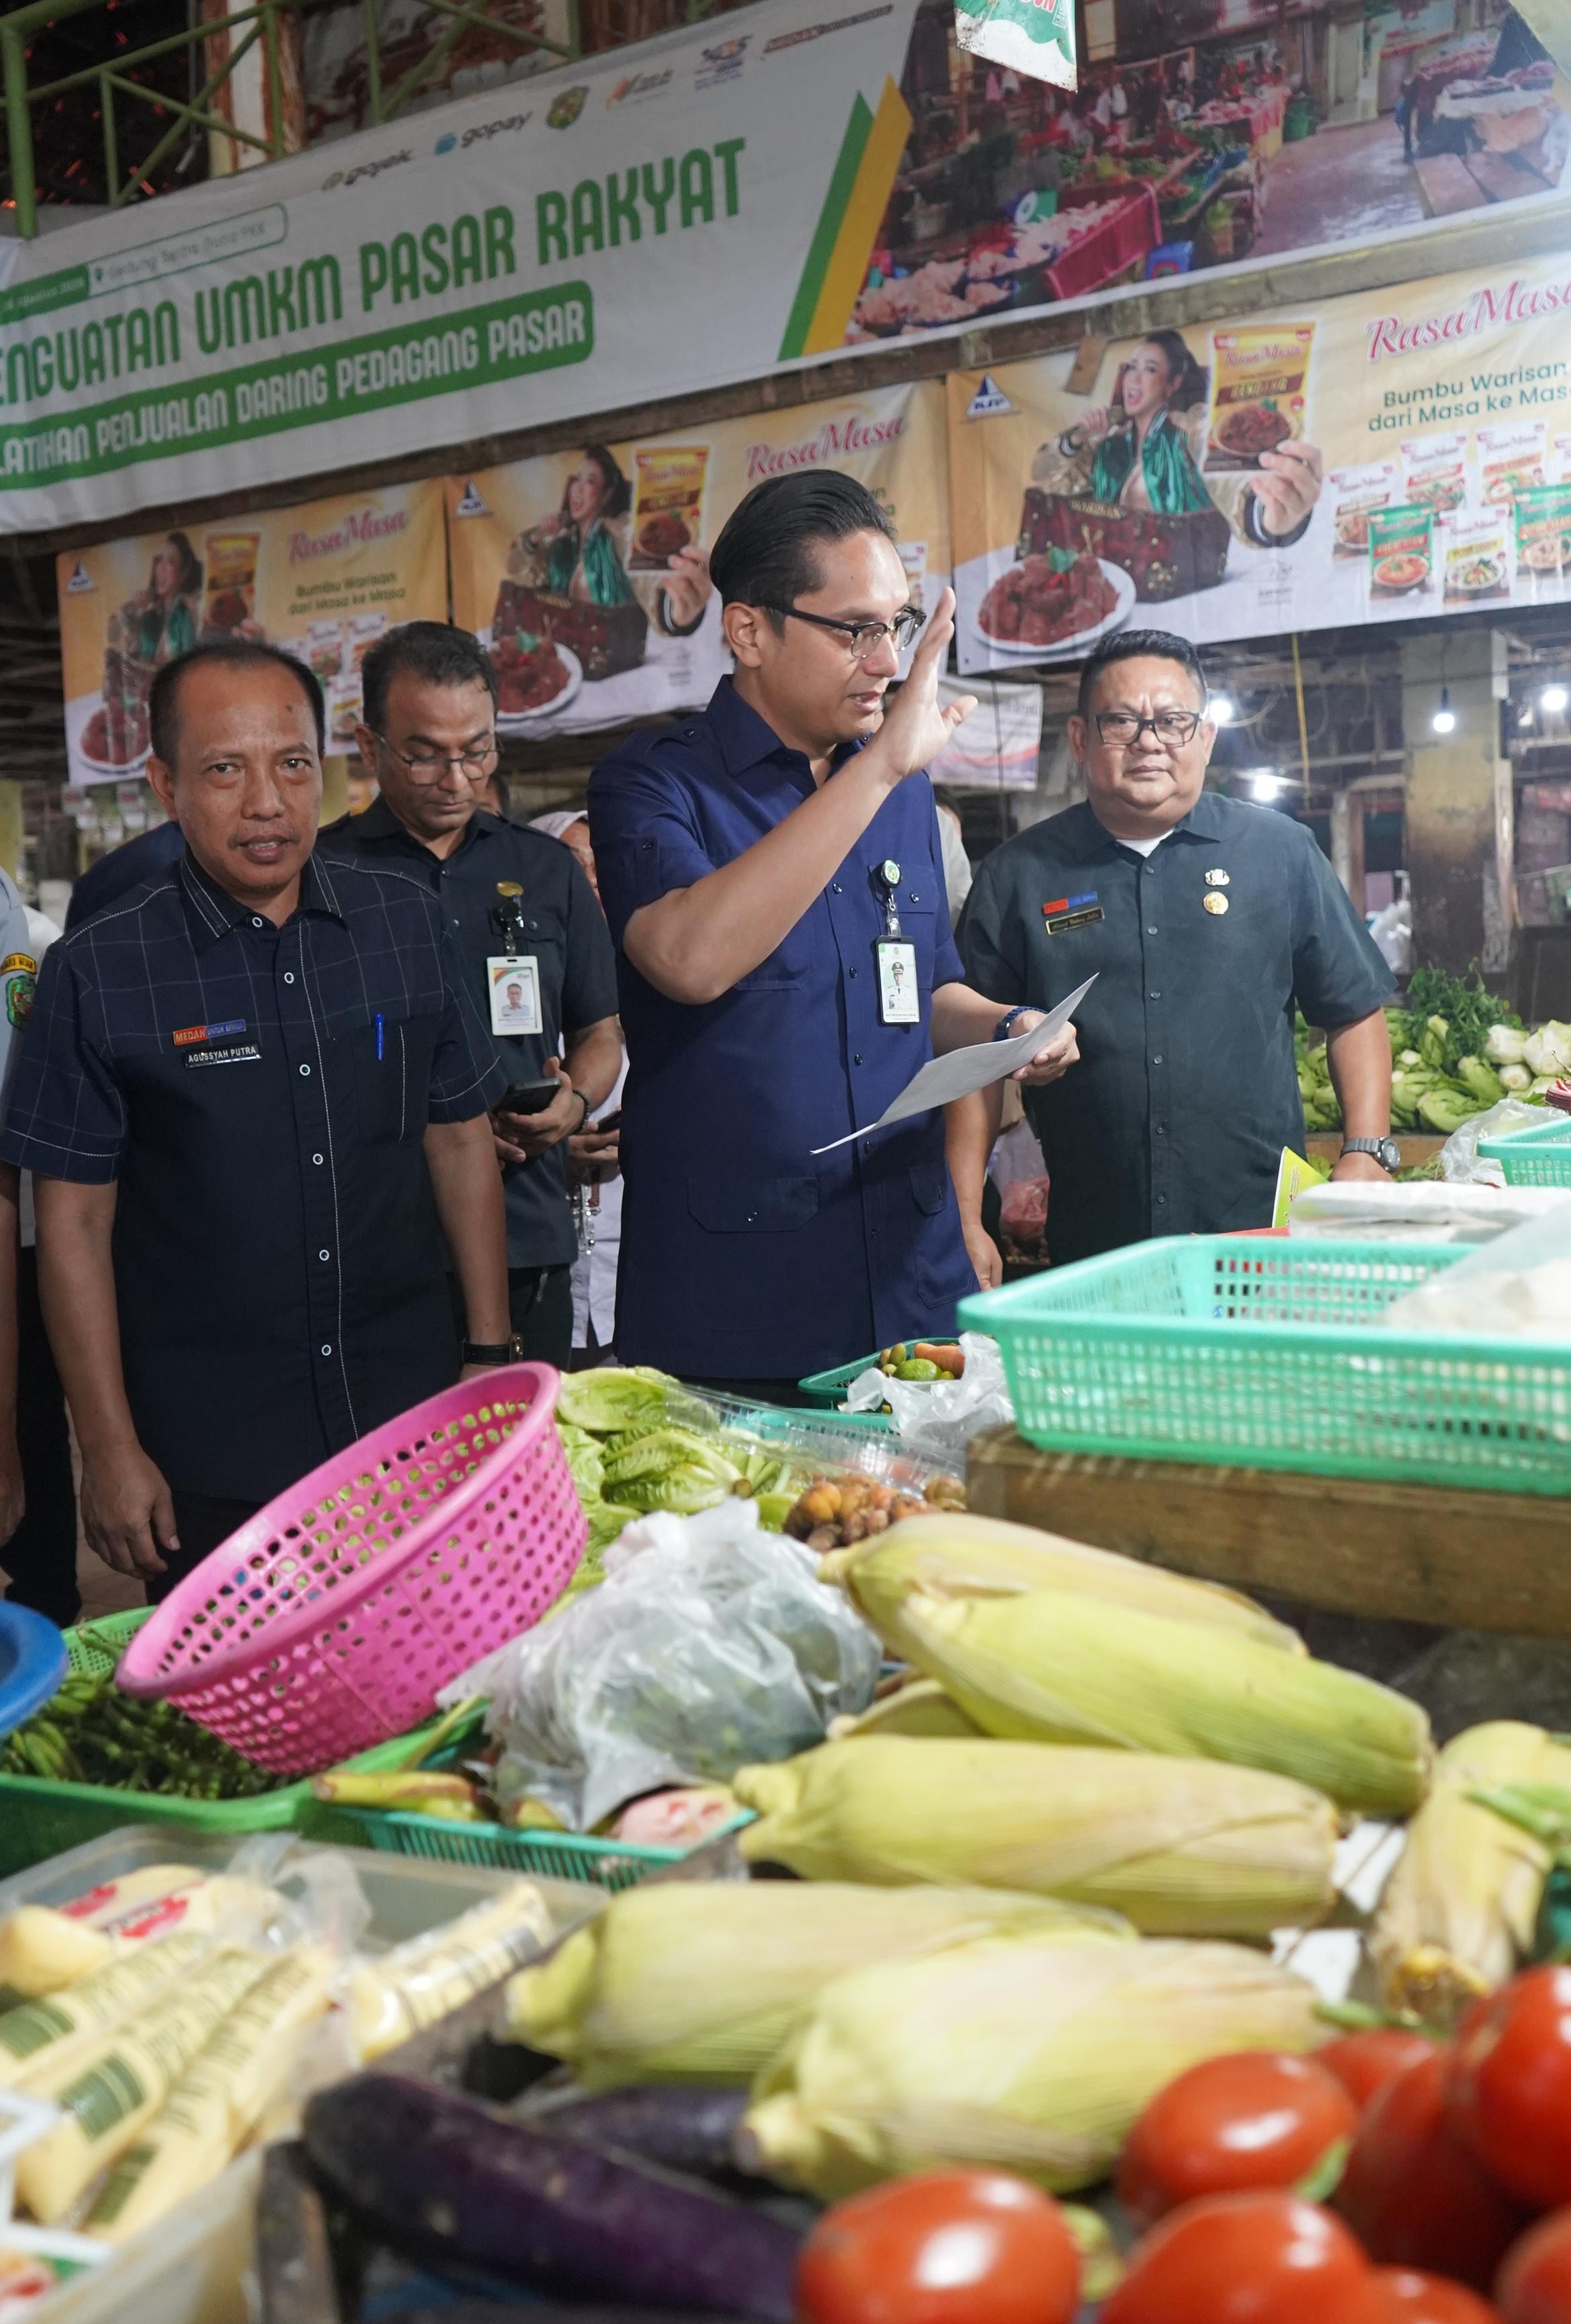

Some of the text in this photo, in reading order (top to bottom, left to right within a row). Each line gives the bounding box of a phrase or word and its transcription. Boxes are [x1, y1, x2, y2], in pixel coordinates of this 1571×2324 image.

[0, 137, 745, 407] NGUATAN UMKM PASAR RAKYAT
[97, 389, 228, 456] PENJUALAN
[236, 363, 328, 423] DARING
[337, 327, 478, 399] PEDAGANG
[488, 300, 585, 363] PASAR
[1383, 361, 1568, 408] Bumbu Warisan
[1368, 385, 1571, 432] dari Masa ke Mas
[175, 1030, 205, 1043] MEDAN
[189, 1046, 256, 1063] AGUSSYAH PUTRA
